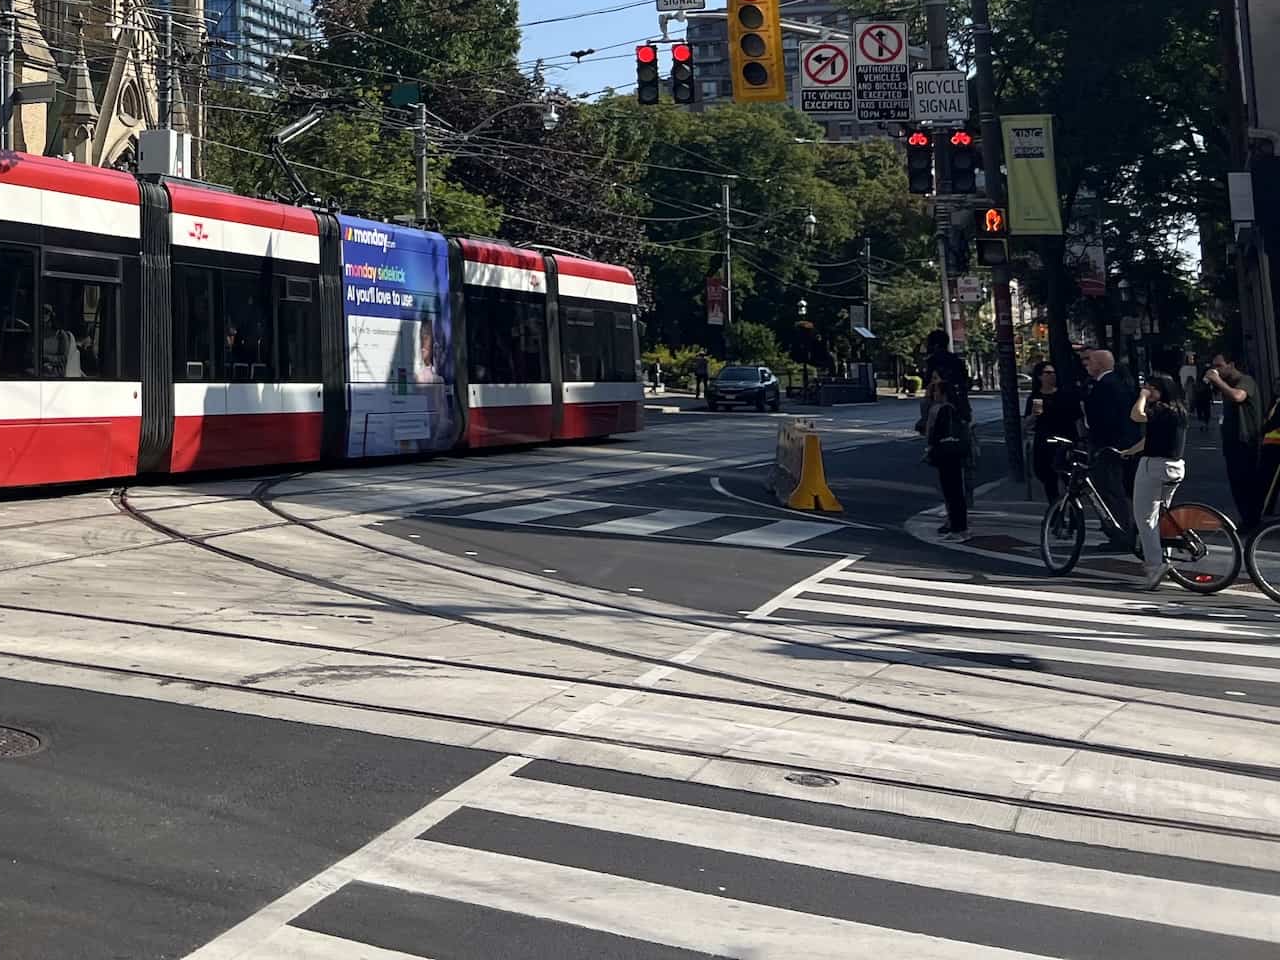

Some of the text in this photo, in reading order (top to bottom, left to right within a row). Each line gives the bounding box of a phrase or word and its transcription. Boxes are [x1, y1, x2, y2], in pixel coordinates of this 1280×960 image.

[858, 65, 906, 73] AUTHORIZED
[858, 82, 907, 90] AND BICYCLES
[916, 80, 965, 95] BICYCLE
[803, 91, 851, 100] TTC VEHICLES
[863, 91, 902, 99] EXCEPTED
[804, 101, 850, 110] EXCEPTED
[919, 99, 963, 113] SIGNAL
[345, 263, 406, 283] monday sidekick
[376, 287, 391, 305] love
[392, 290, 400, 306] to
[401, 293, 414, 307] use
